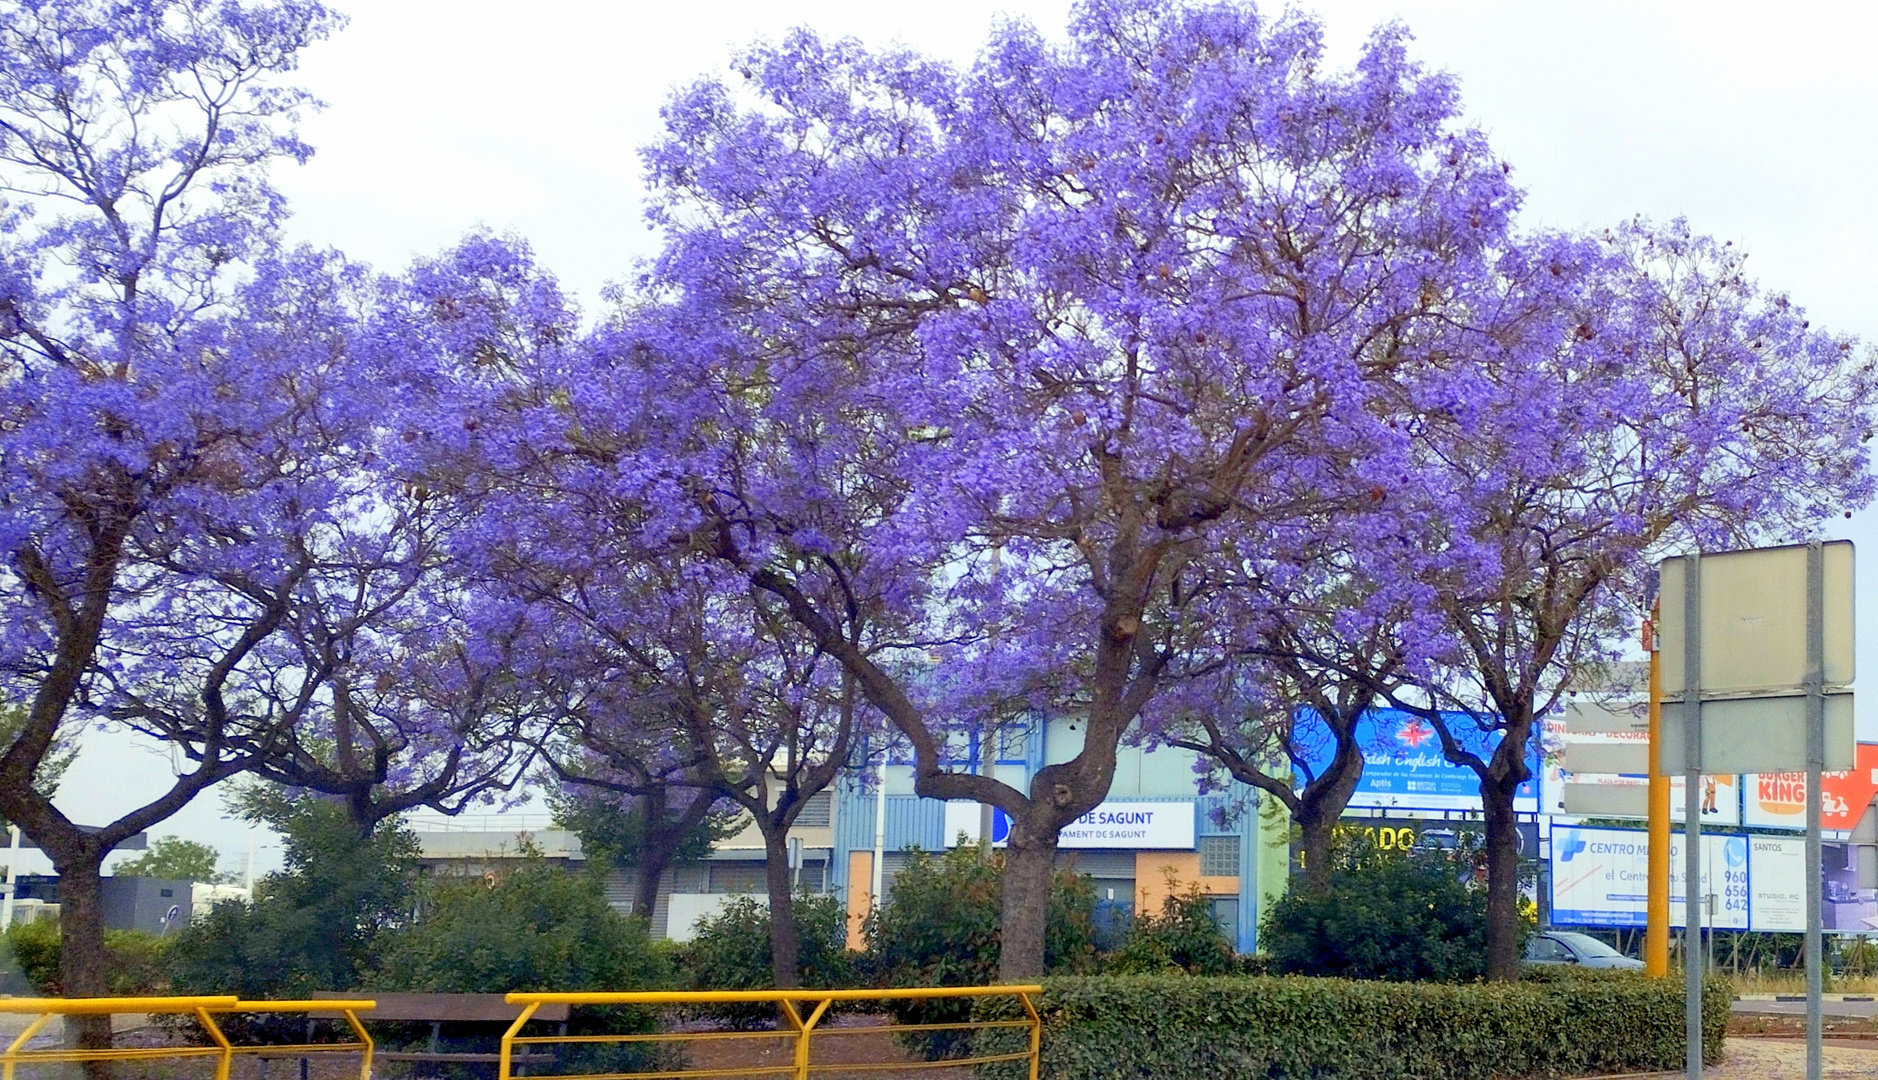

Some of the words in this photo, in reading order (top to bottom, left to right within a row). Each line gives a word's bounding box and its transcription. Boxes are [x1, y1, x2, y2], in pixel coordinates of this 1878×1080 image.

[1395, 752, 1440, 772] English
[1370, 779, 1391, 788] Aptis
[1759, 781, 1805, 803] KING
[1079, 812, 1095, 824] DE
[1099, 812, 1153, 824] SAGUNT
[1590, 842, 1634, 855] CENTRO
[1753, 843, 1782, 852] SANTOS
[1605, 870, 1614, 880] el
[1724, 871, 1746, 883] 960
[1725, 885, 1747, 897] 656
[1725, 899, 1747, 911] 642
